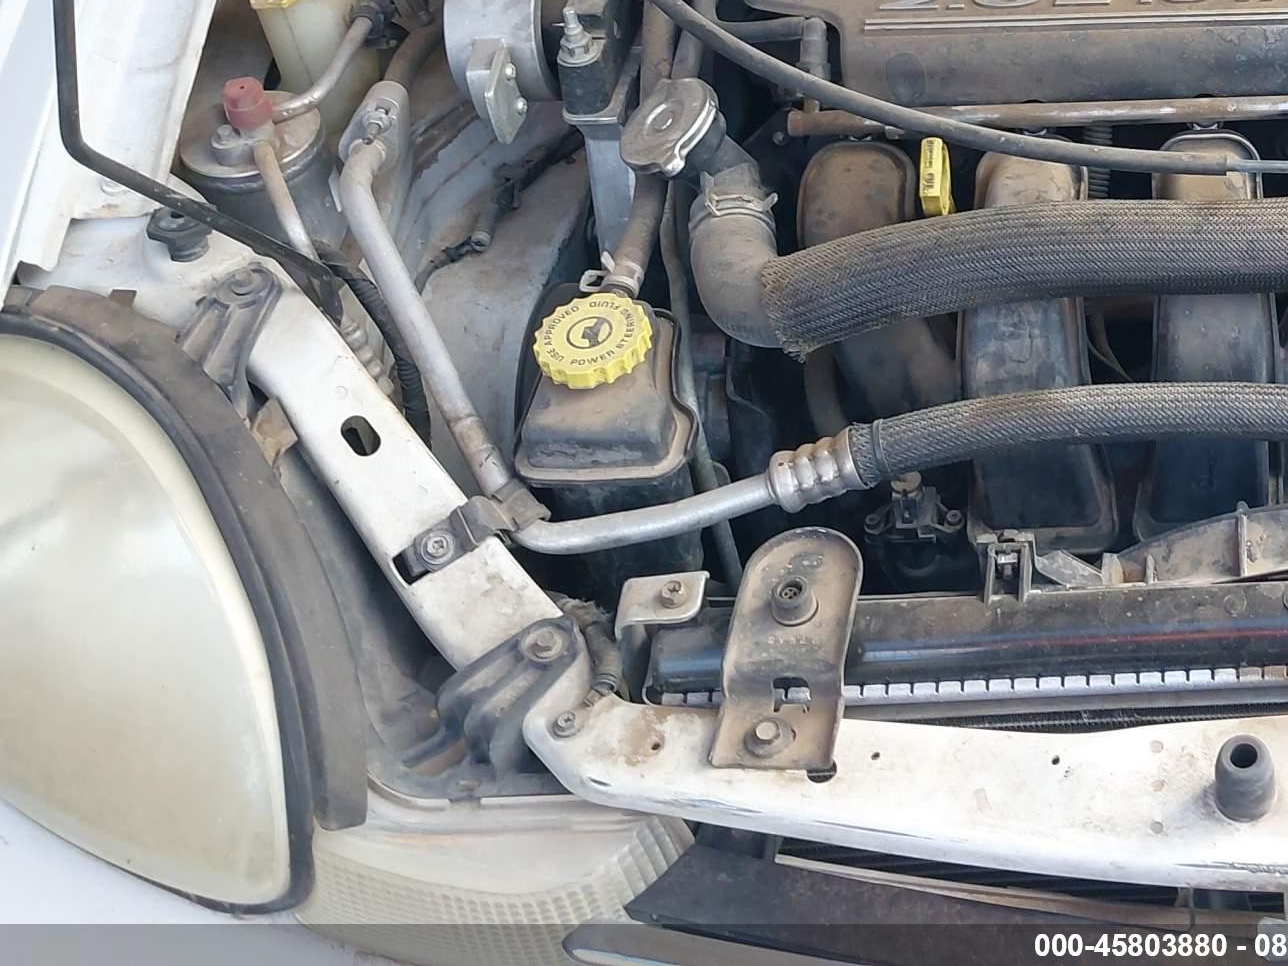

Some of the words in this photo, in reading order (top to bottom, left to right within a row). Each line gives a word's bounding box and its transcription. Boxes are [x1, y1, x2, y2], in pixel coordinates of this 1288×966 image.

[588, 300, 622, 312] FLUID
[544, 305, 580, 347] APPROVED
[616, 308, 637, 351] STEERING
[546, 347, 565, 363] USE
[569, 350, 616, 366] POWER
